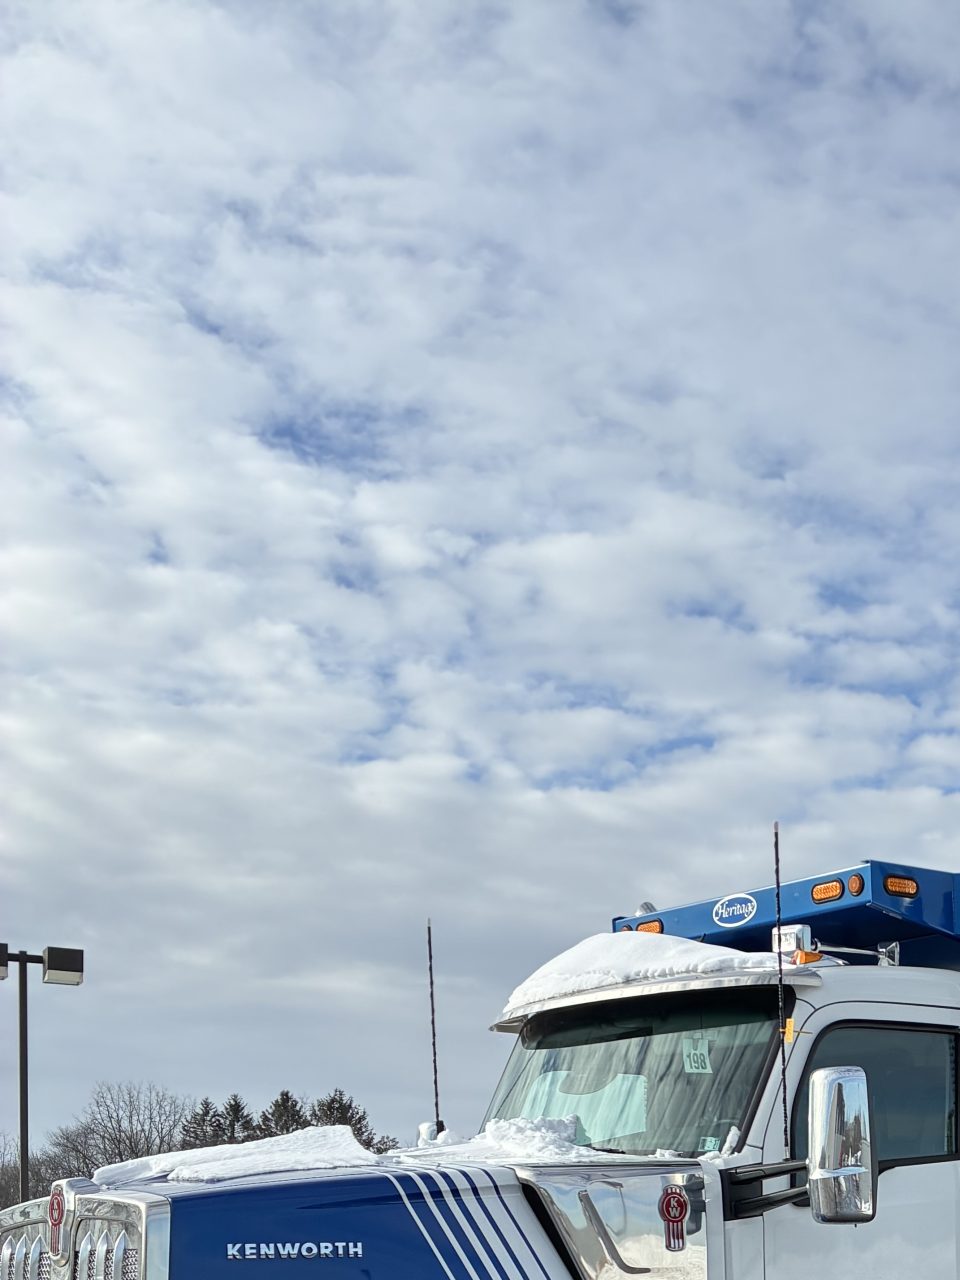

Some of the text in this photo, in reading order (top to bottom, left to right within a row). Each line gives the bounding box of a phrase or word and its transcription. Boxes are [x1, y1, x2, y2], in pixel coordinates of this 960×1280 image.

[714, 901, 755, 919] Heritage
[686, 1052, 708, 1070] 198
[226, 1242, 363, 1259] KENWORTH
